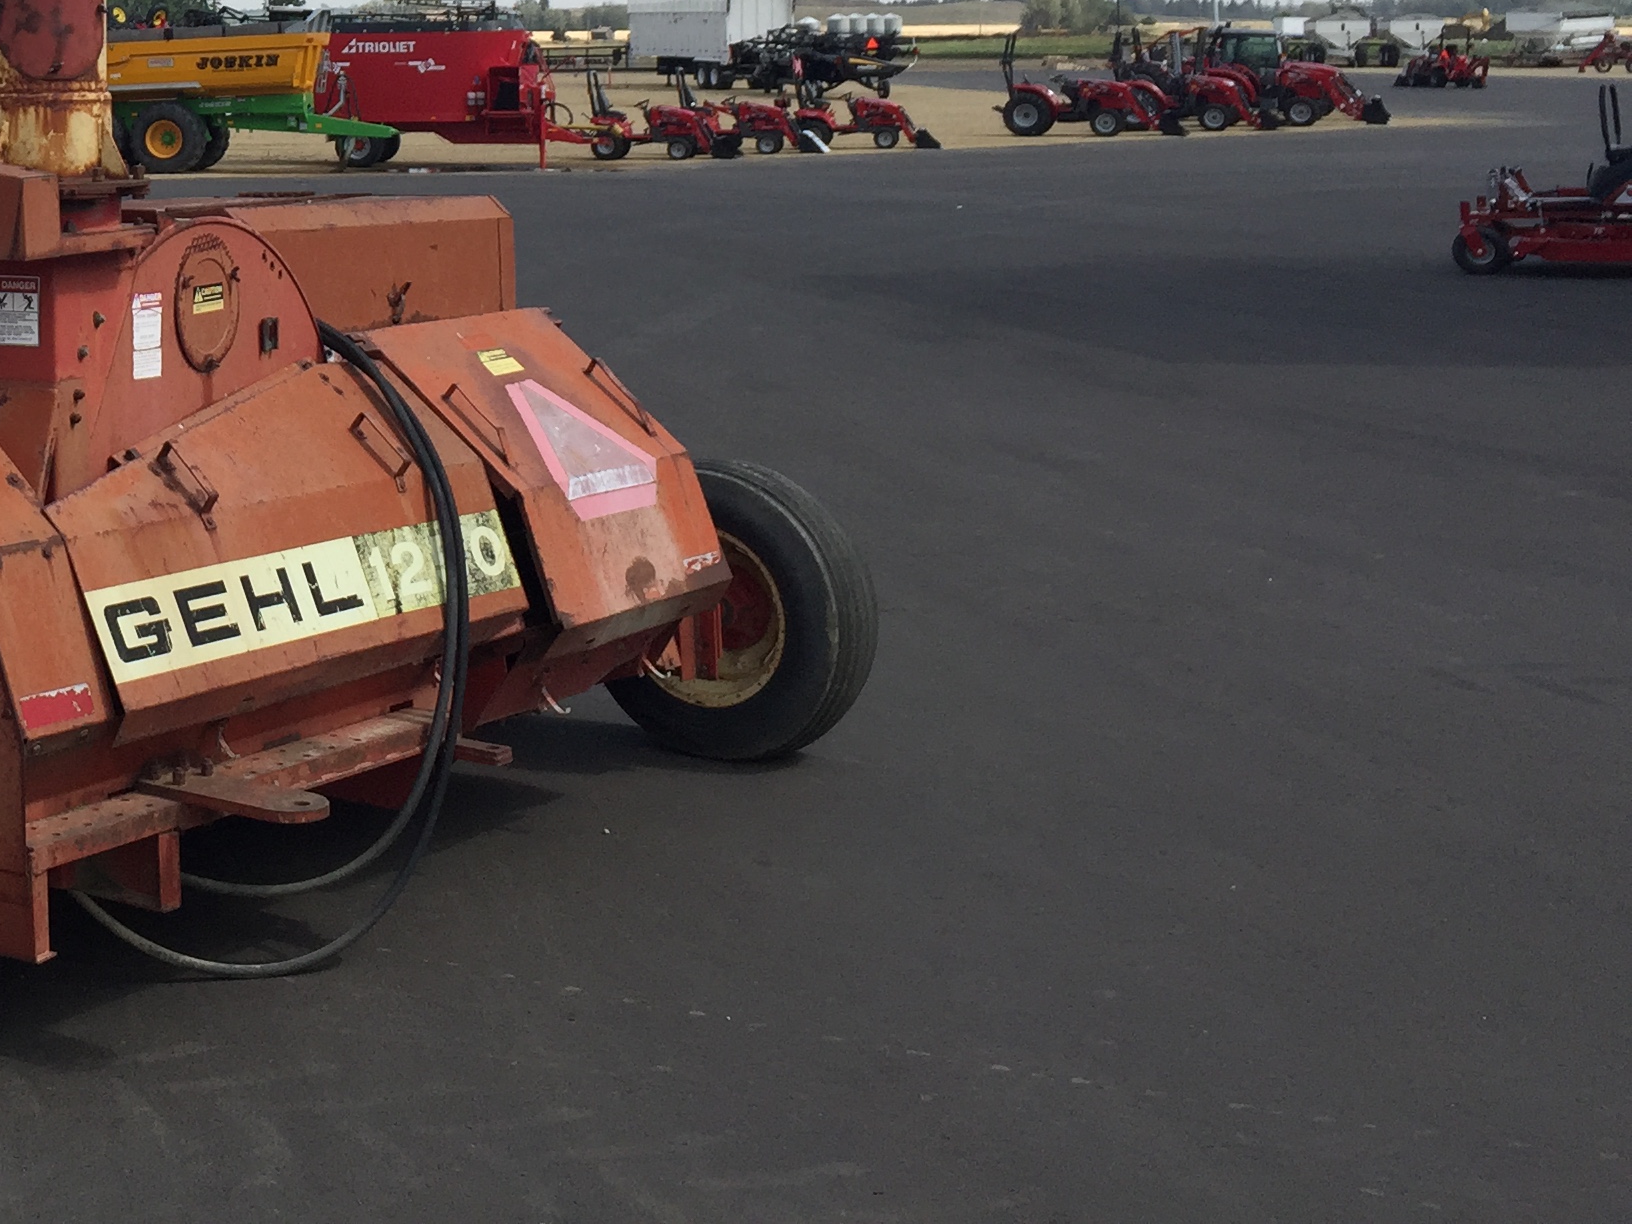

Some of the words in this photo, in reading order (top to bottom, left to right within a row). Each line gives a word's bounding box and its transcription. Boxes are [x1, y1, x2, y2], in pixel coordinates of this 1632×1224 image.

[356, 41, 416, 53] TRIOLIET
[196, 54, 280, 70] JOSKIN
[1, 280, 36, 290] DANGER
[103, 561, 364, 664] GEHL
[368, 525, 507, 602] 120
